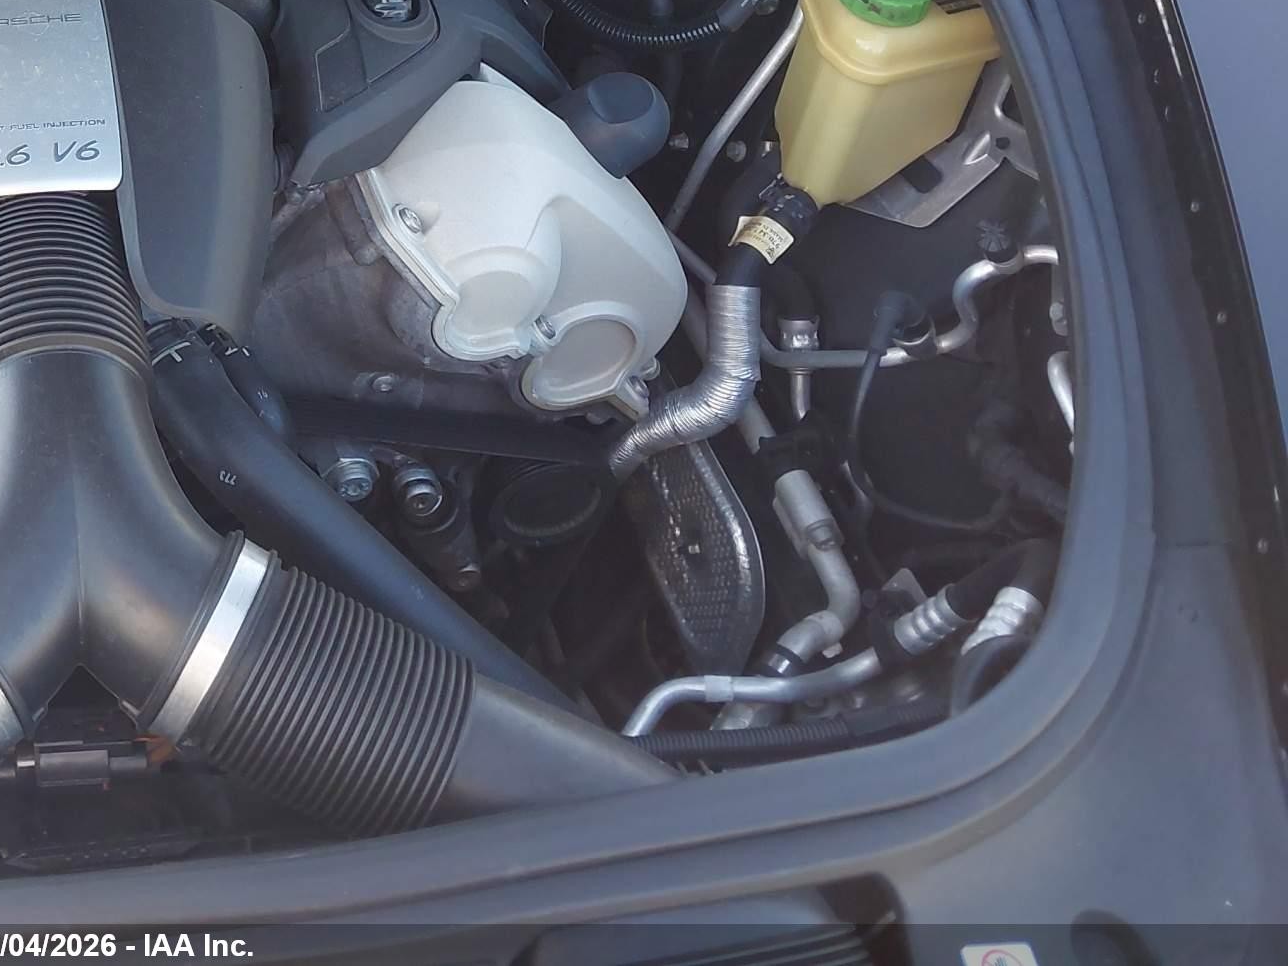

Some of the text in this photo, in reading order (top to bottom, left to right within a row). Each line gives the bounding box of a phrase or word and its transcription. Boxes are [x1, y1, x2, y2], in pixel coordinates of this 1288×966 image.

[9, 122, 40, 131] FUEL
[42, 118, 106, 129] INJECTION
[52, 139, 100, 163] V6
